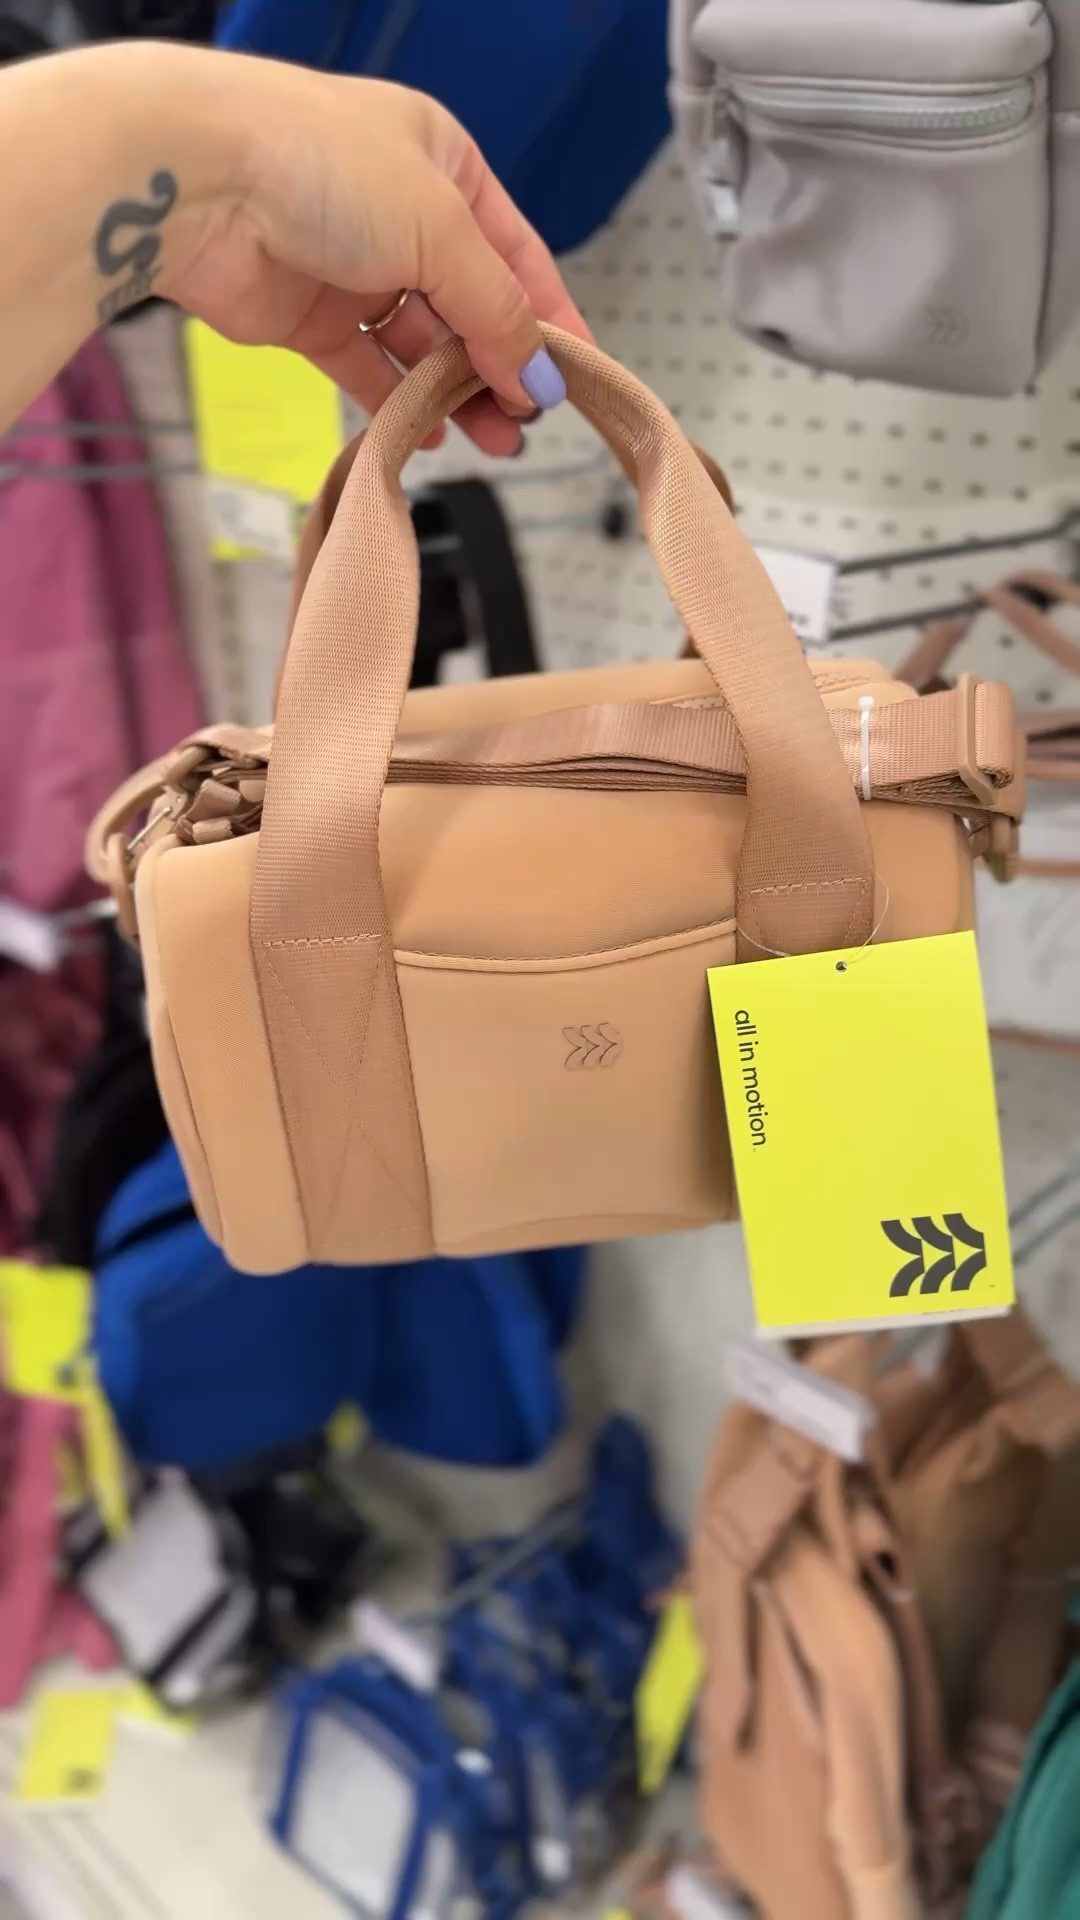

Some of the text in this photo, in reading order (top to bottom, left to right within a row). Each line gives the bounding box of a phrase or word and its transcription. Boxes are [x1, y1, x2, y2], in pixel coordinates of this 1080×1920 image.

[734, 1009, 769, 1146] all in motion
